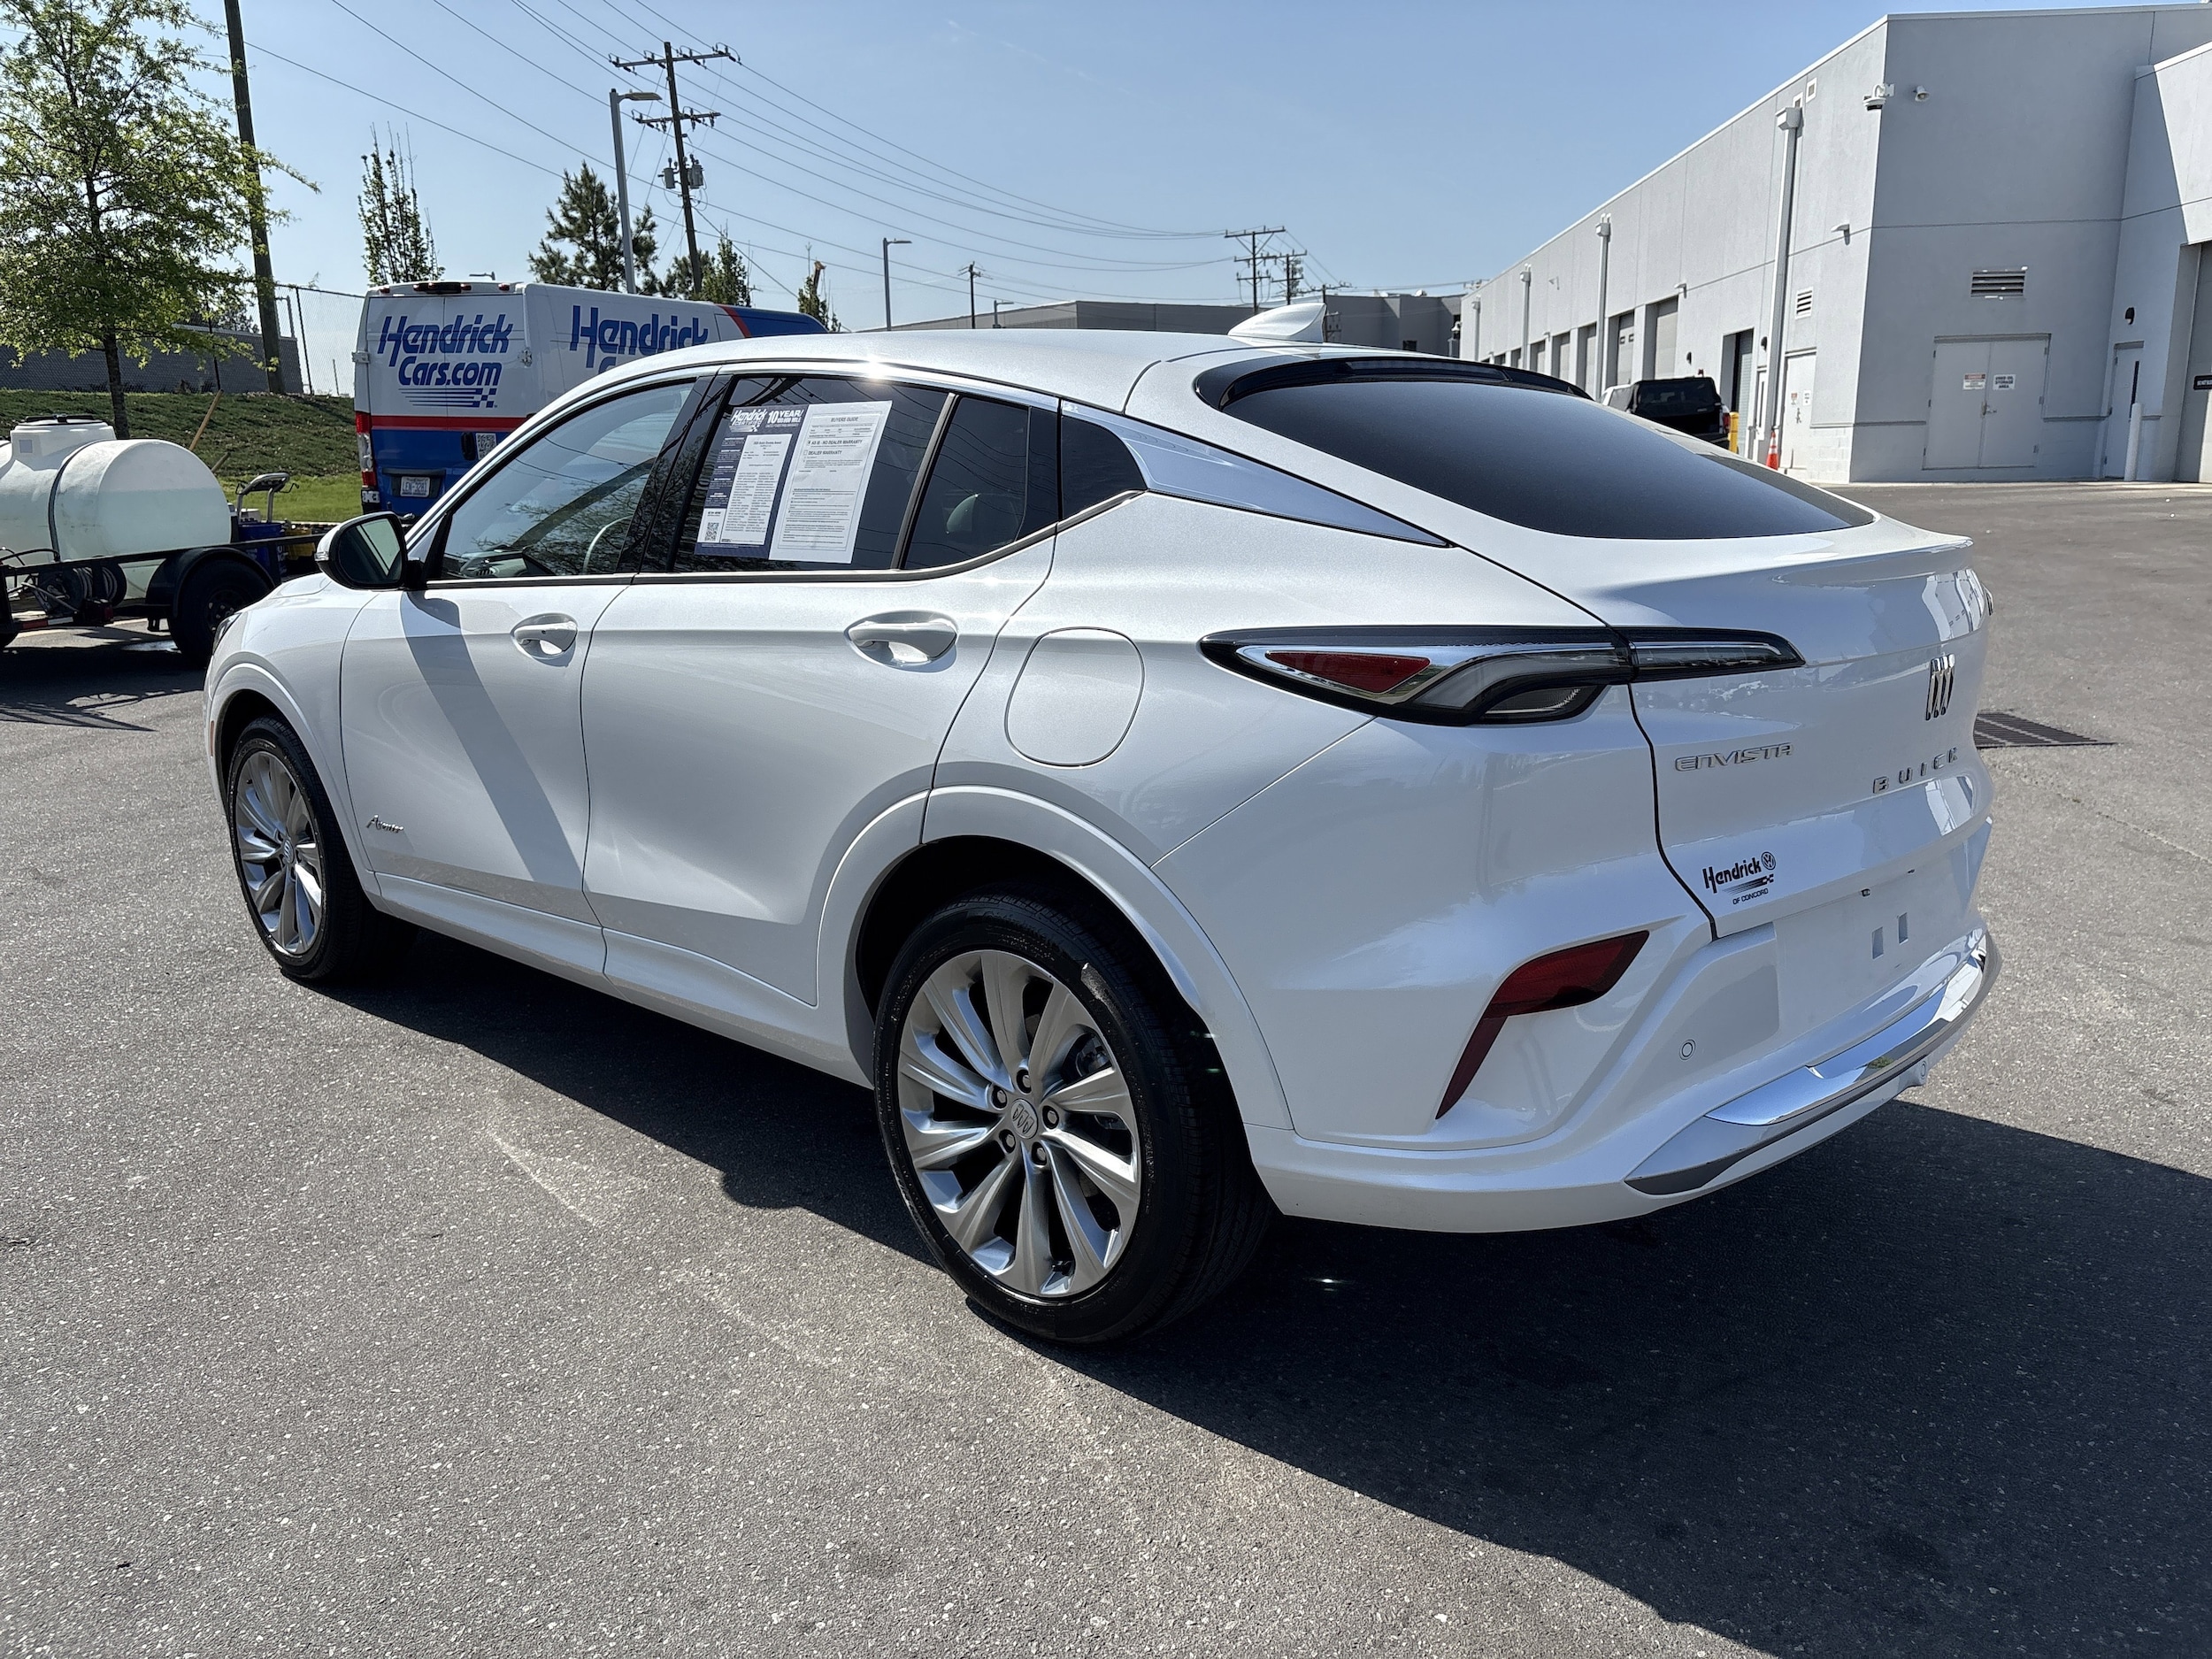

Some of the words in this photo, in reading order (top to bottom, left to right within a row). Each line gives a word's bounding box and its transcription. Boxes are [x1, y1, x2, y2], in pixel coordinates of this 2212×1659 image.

[378, 314, 514, 367] Hendrick
[569, 305, 709, 369] Hendrick
[398, 356, 503, 386] Cars.com
[731, 409, 768, 426] Hendrick
[767, 411, 780, 424] 10
[1675, 742, 1793, 772] ENVISTA
[1872, 748, 1958, 795] BUICK
[1702, 857, 1762, 894] Hendrick
[1741, 888, 1769, 902] CONCORD
